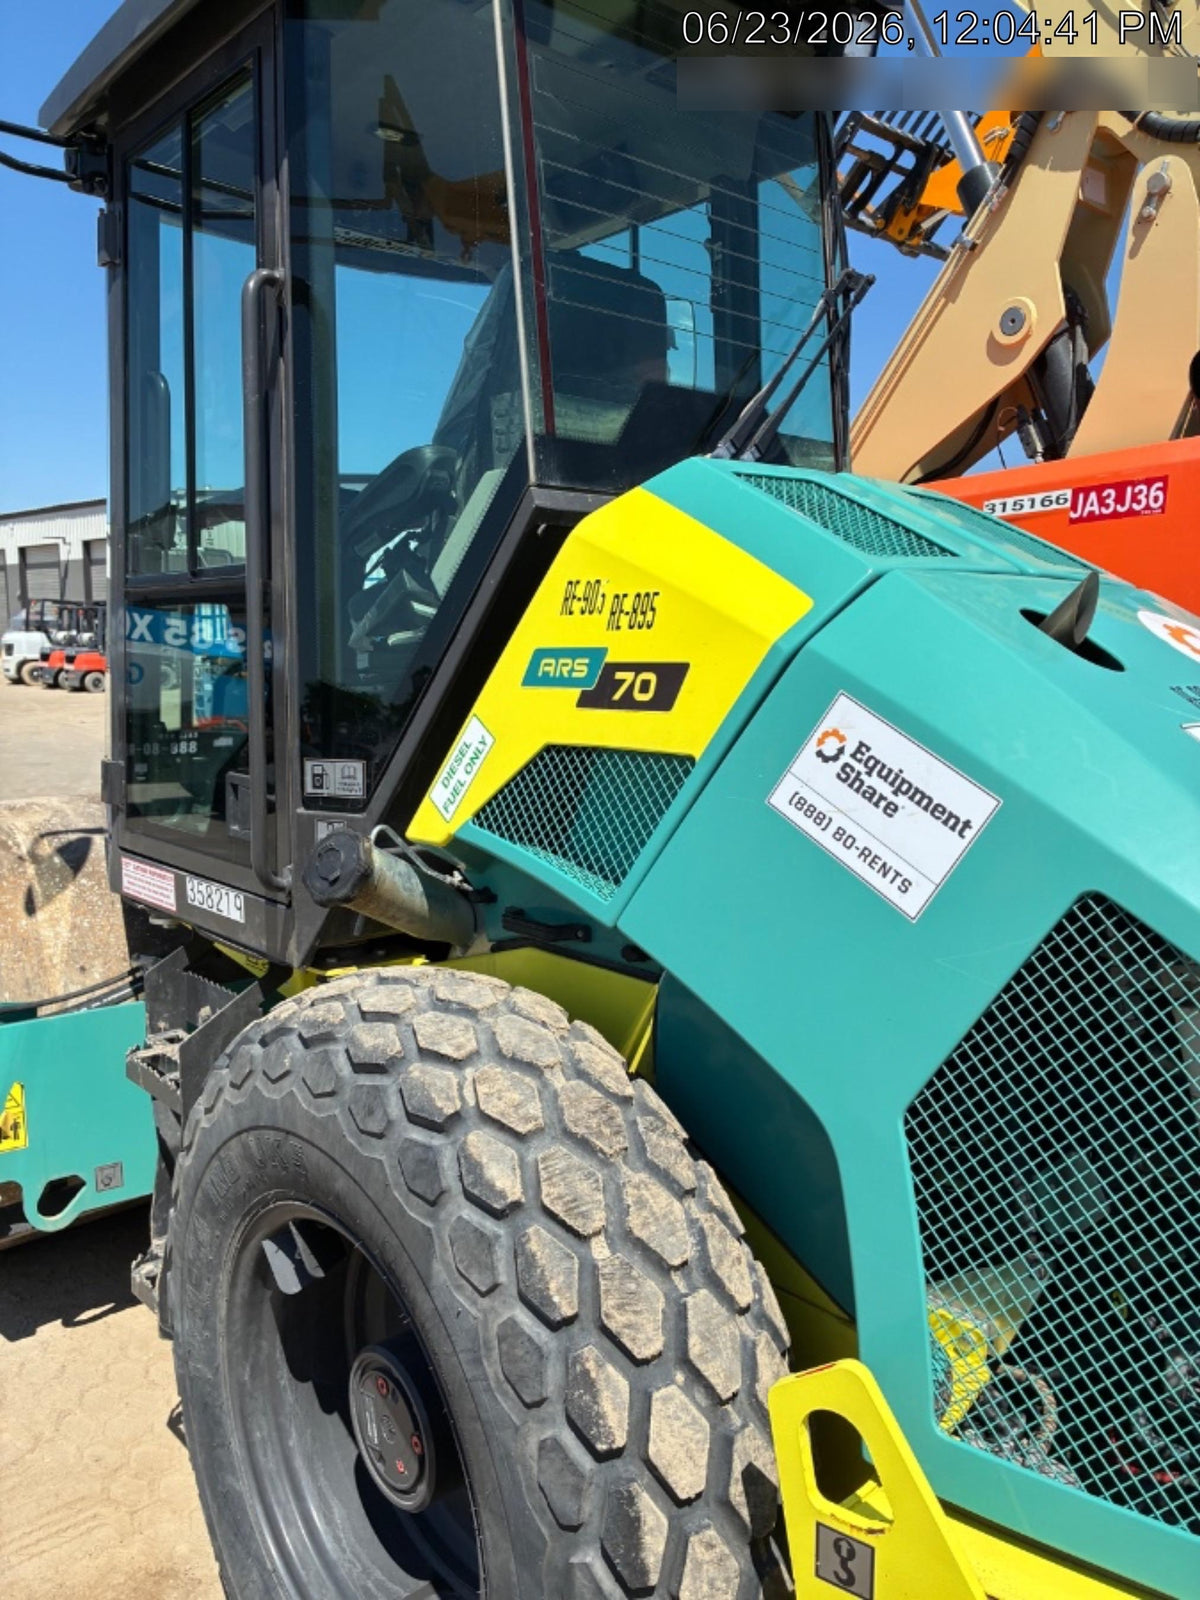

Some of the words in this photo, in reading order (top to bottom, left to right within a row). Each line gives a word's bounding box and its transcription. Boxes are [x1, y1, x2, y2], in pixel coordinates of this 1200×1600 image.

[984, 493, 1069, 514] 315166
[1069, 482, 1165, 519] JA3J36
[606, 591, 660, 631] RE-895
[537, 657, 590, 678] ARS
[611, 671, 657, 702] 70
[441, 741, 472, 789] DIESEL
[442, 779, 466, 814] FUEL
[464, 734, 488, 775] ONLY
[835, 761, 900, 818] Share
[849, 740, 973, 839] Equipment
[788, 790, 833, 832] (888)
[831, 826, 913, 894] 80-RENTS
[188, 877, 242, 920] 358219
